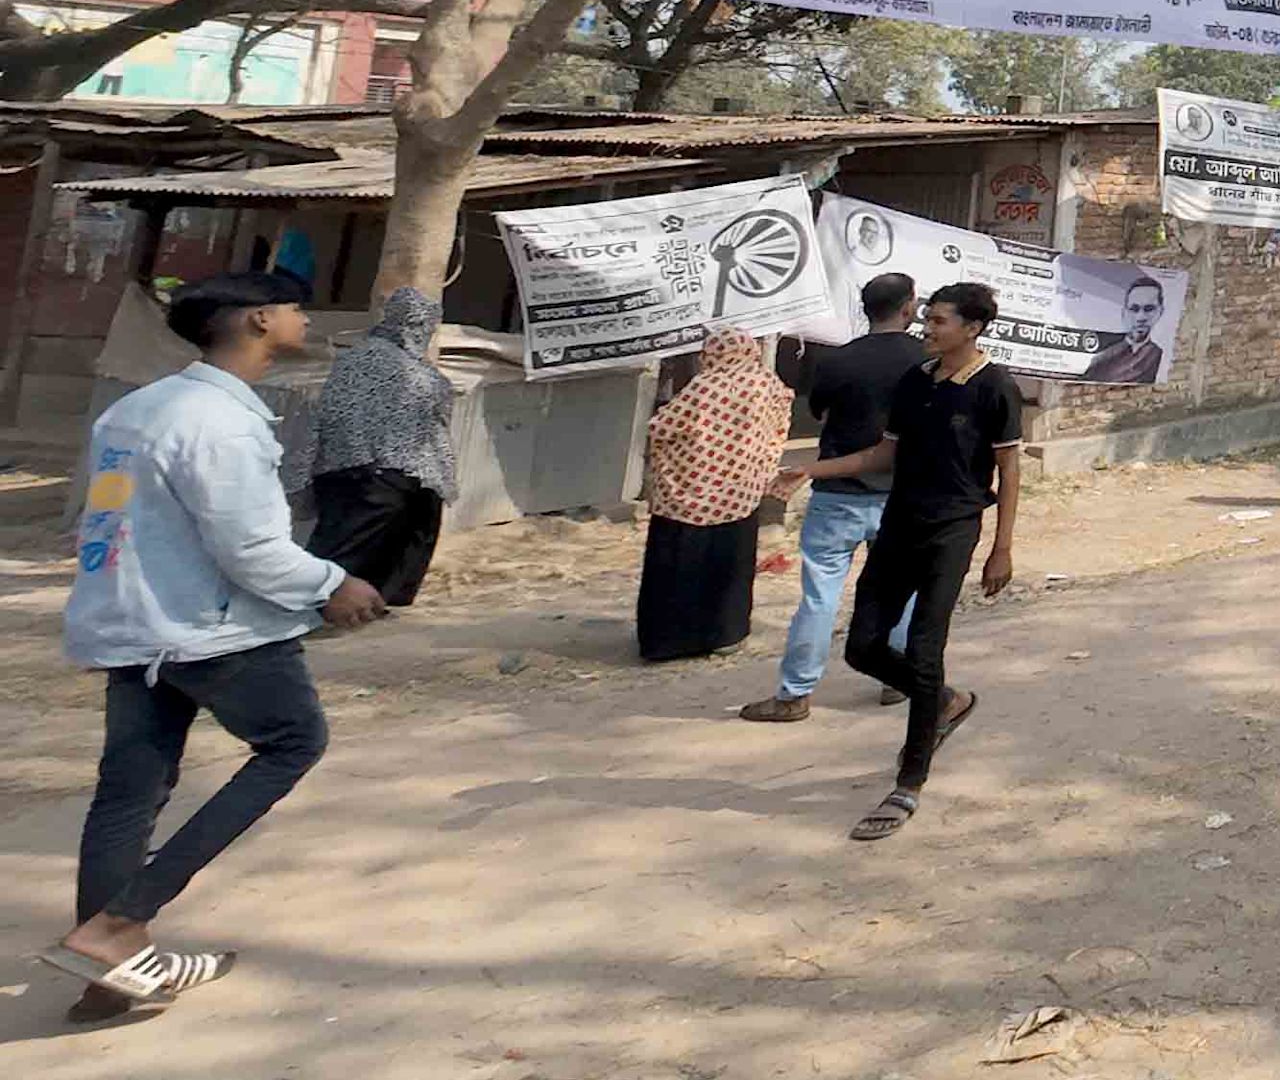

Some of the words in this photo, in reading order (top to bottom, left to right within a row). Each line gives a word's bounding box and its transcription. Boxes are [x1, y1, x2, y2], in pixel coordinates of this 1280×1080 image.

[1169, 153, 1200, 175] মো.
[1205, 159, 1256, 185] আব্দুল
[1017, 323, 1081, 348] আজিজ
